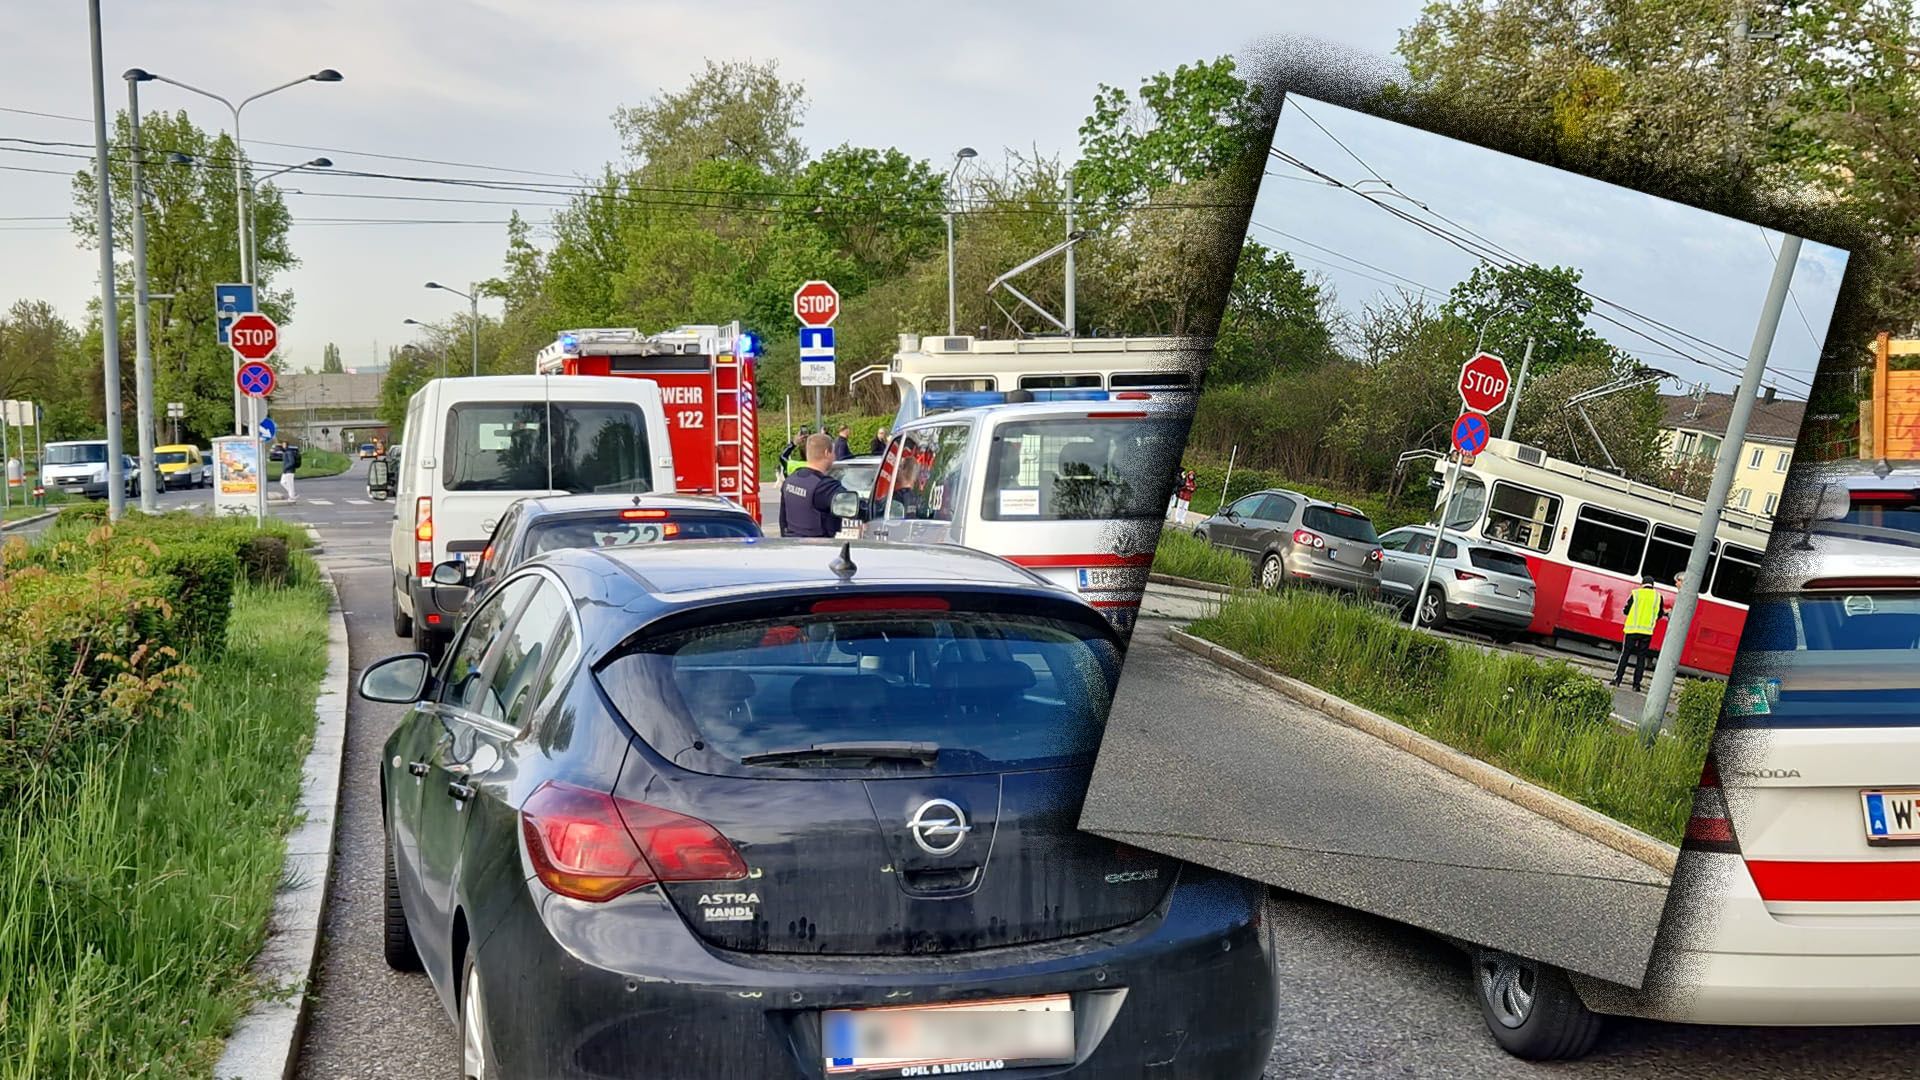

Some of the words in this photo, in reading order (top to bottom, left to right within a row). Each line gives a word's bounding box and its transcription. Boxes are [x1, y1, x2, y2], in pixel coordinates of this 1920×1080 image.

[799, 295, 834, 313] STOP
[234, 329, 274, 346] STOP
[1464, 369, 1504, 398] STOP
[658, 386, 703, 404] WEHR
[677, 410, 704, 429] 122
[721, 477, 736, 488] 33
[785, 483, 807, 498] POLIZEI
[1891, 800, 1912, 830] W
[697, 892, 760, 905] ASTRA
[704, 906, 754, 917] KANDL
[901, 1066, 930, 1077] OPEL
[932, 1064, 941, 1075] &
[943, 1059, 1005, 1074] BEYSCHLAG
